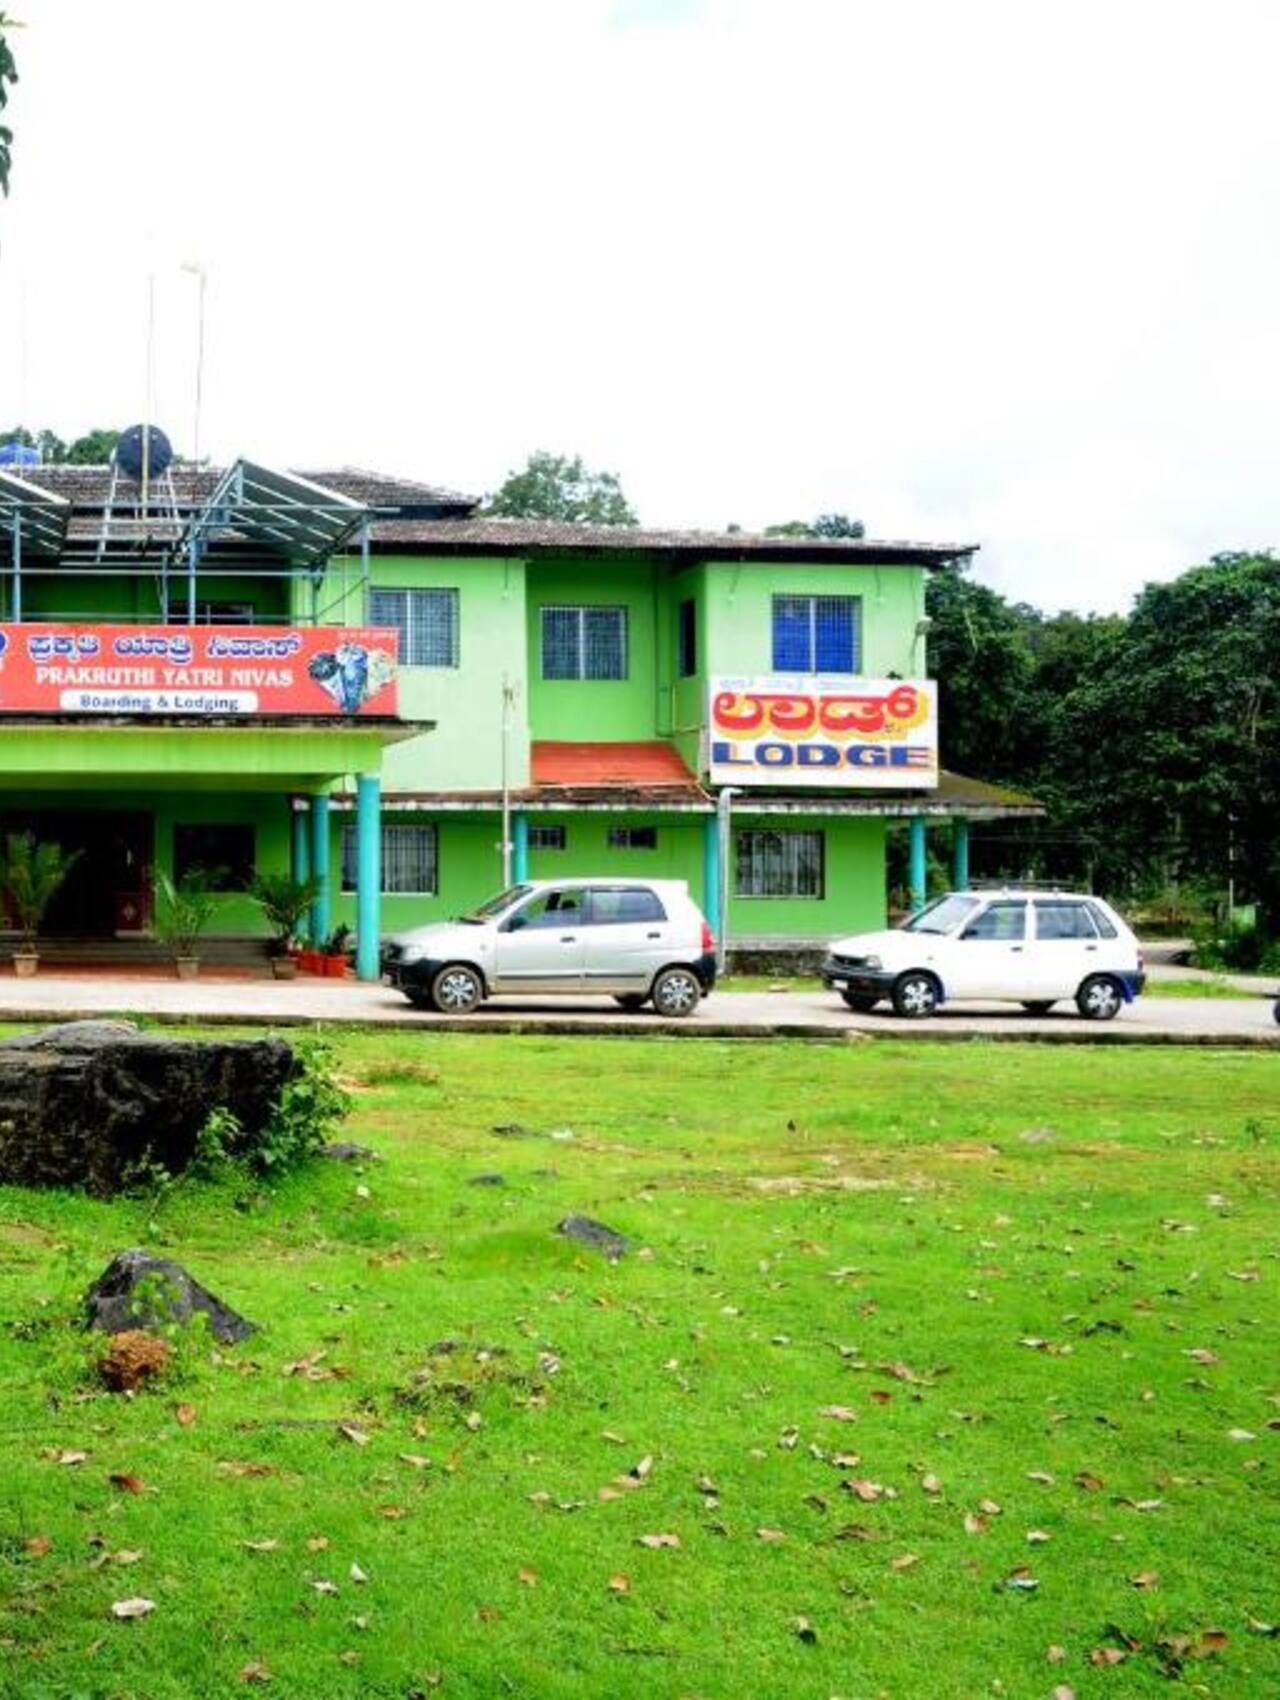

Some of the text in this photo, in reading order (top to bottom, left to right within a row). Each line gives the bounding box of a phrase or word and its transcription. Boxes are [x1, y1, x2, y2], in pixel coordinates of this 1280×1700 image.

[36, 667, 293, 687] PRAKRUTHI YATRI NIVAS
[80, 695, 239, 711] Boarding & Lodging
[712, 742, 930, 767] LODGE
